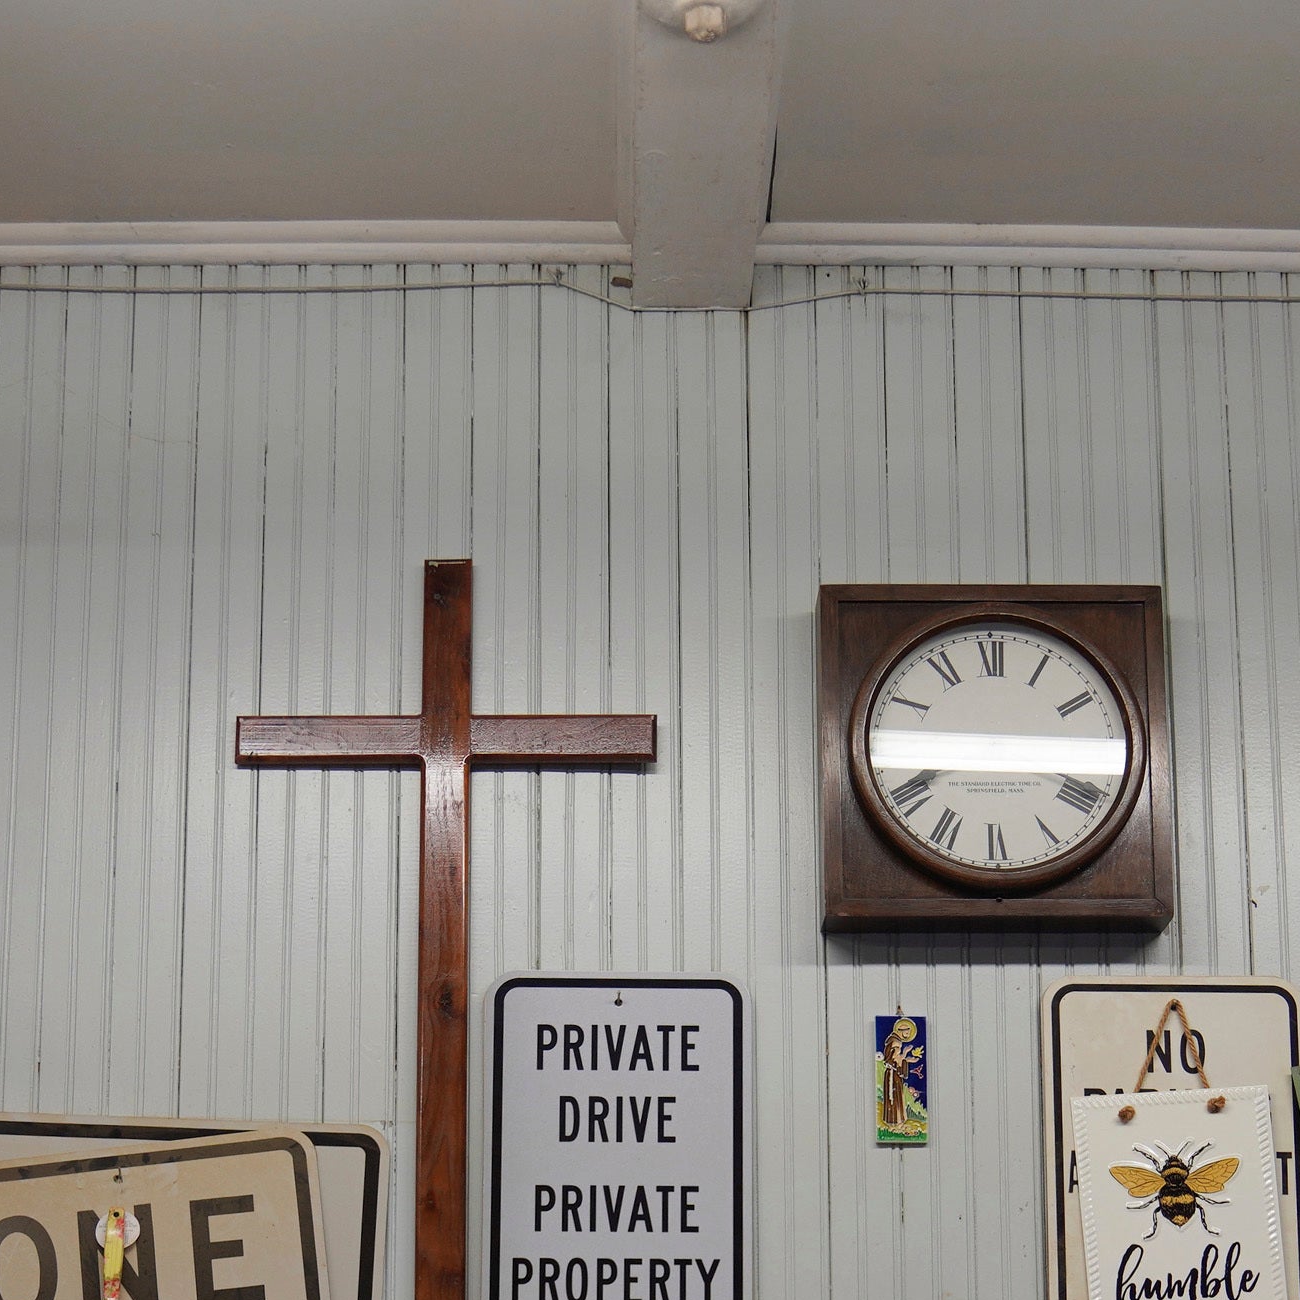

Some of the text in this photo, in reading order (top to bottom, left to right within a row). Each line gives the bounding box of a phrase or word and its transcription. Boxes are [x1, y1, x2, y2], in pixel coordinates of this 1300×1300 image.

[536, 1024, 700, 1072] PRIVATE
[1146, 1029, 1206, 1075] NO
[558, 1095, 677, 1143] DRIVE
[534, 1185, 700, 1233] PRIVATE
